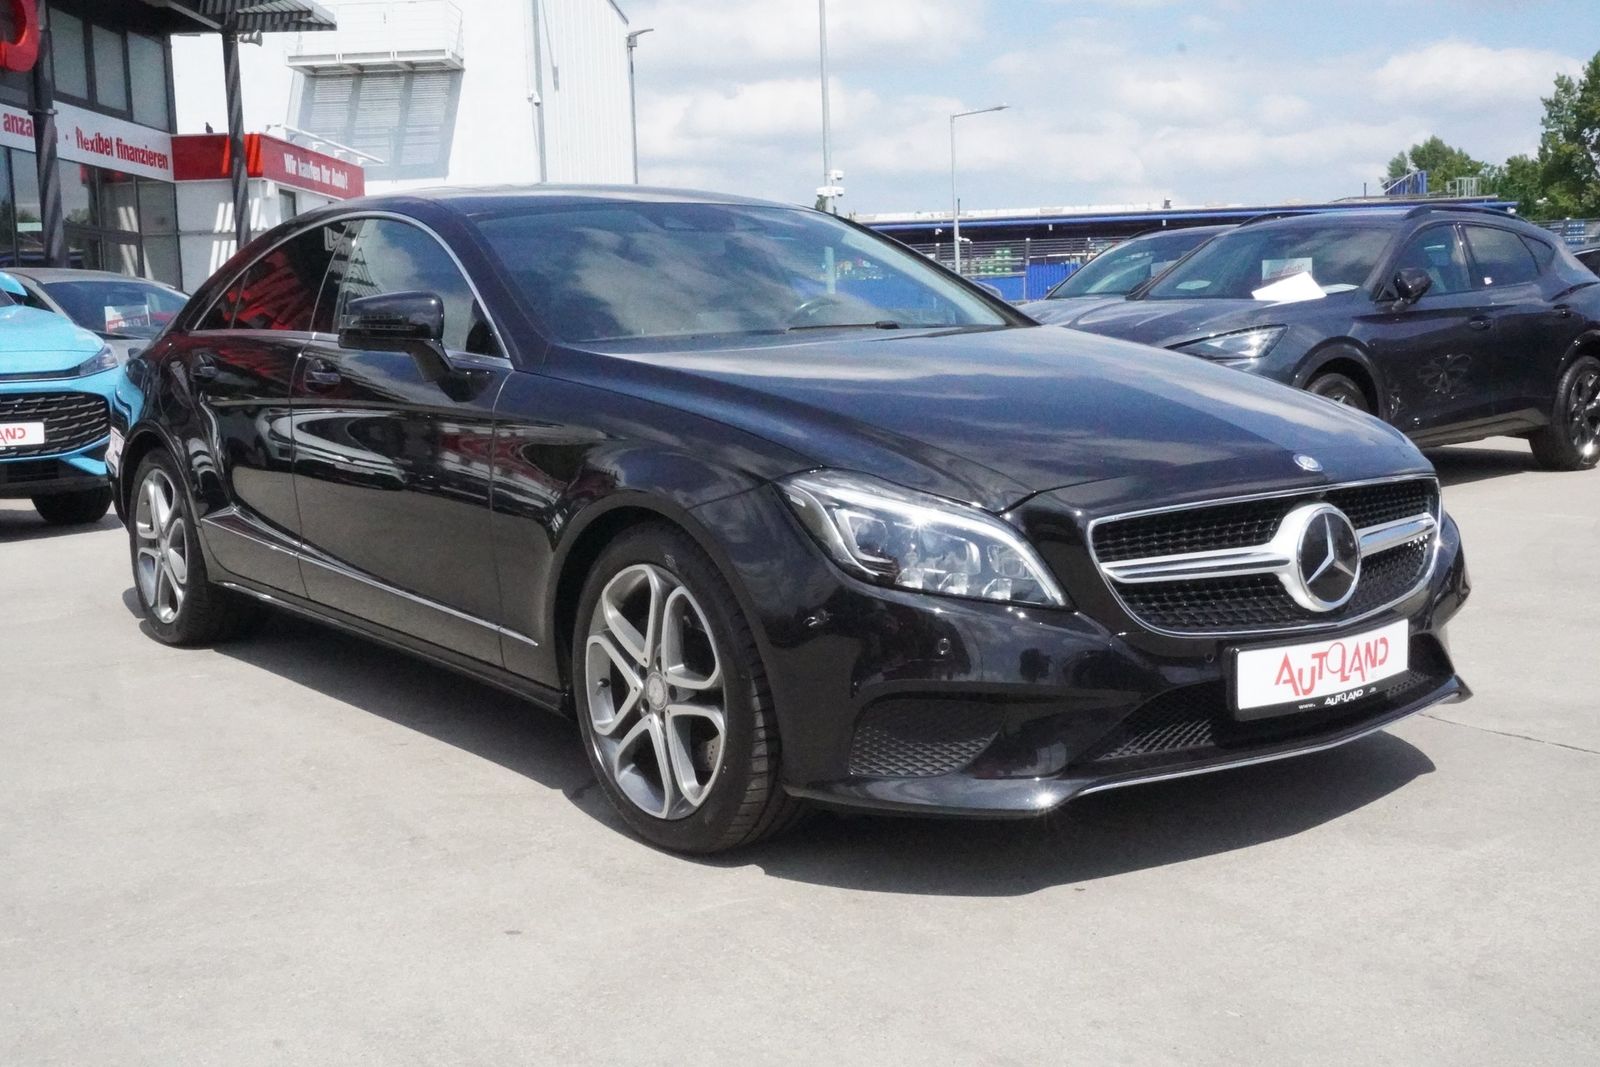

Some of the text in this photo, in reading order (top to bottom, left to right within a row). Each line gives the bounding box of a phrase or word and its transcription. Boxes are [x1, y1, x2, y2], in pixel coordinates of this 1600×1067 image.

[75, 126, 114, 157] flexibel
[116, 136, 169, 170] finanzieren
[1274, 636, 1389, 697] AUTOLAND
[1324, 689, 1364, 705] AUTOLAND
